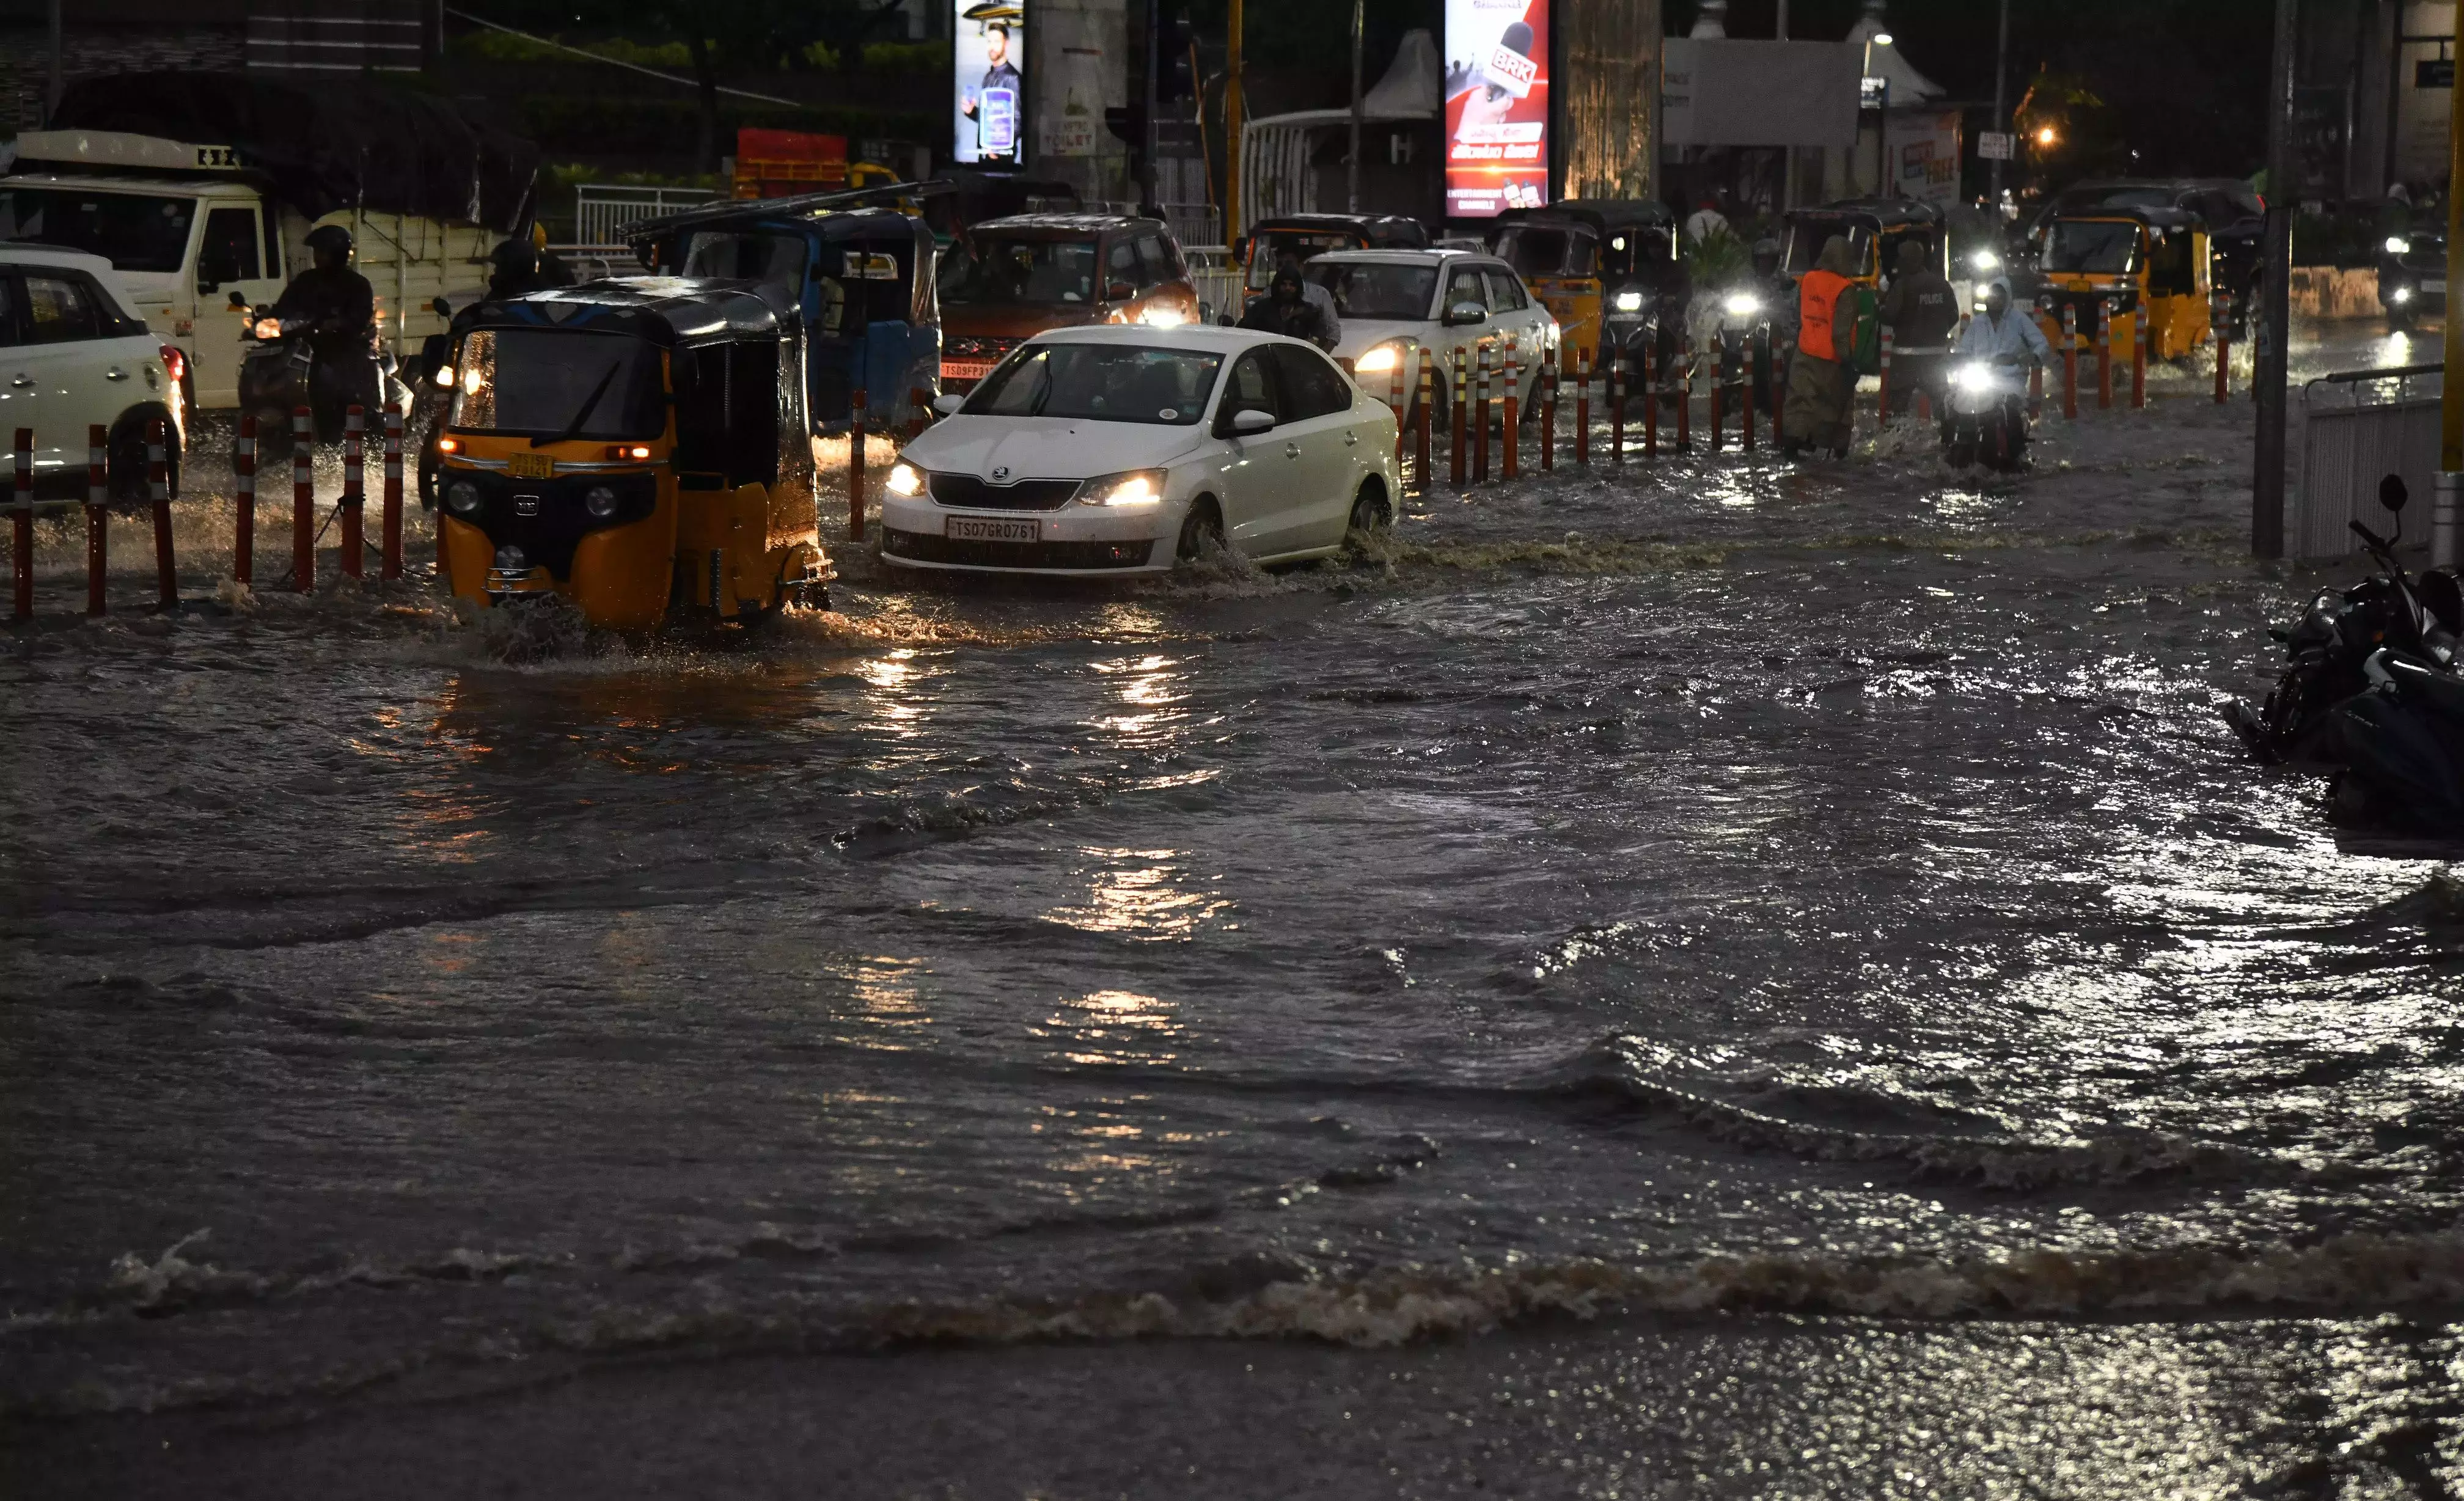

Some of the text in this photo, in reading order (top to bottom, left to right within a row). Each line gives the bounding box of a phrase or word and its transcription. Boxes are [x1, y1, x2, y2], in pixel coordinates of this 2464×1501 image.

[1492, 50, 1532, 83] BRK
[1919, 293, 1945, 305] POLICE
[945, 365, 994, 376] TS09FP31
[956, 521, 1036, 539] TS07GR0761
